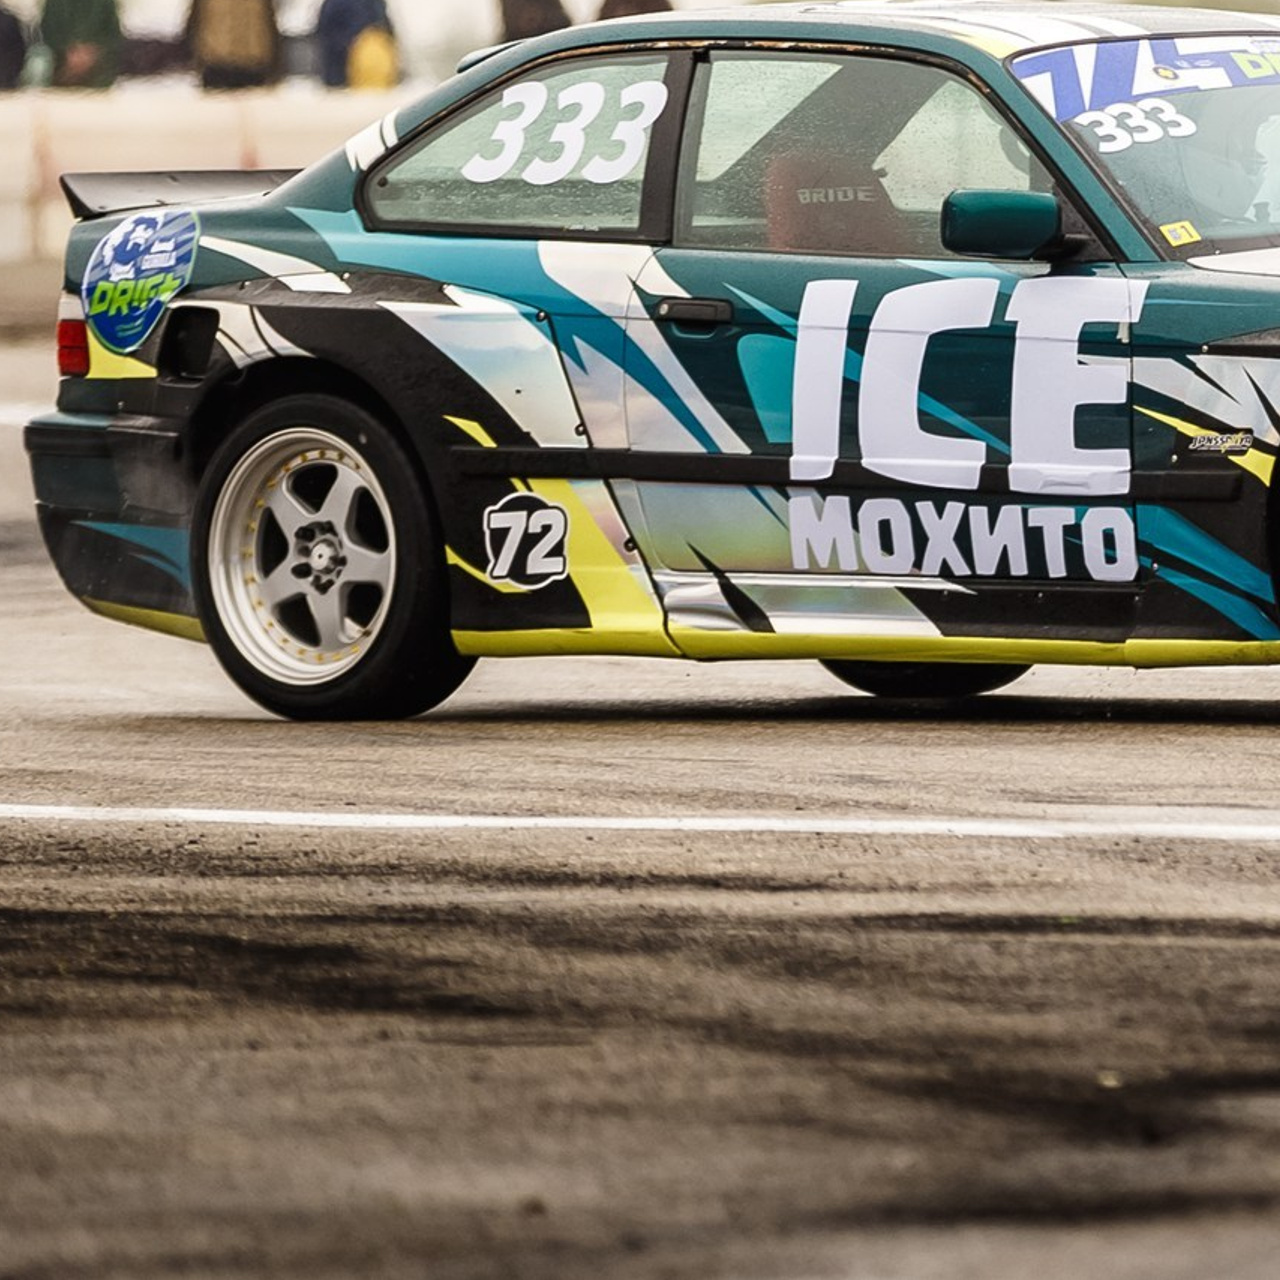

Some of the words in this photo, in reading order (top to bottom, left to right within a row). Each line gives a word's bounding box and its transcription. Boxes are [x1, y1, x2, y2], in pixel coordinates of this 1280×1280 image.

[460, 81, 669, 185] 333
[1074, 97, 1197, 154] 333
[797, 186, 876, 204] BRIDE
[89, 272, 182, 316] DRIFT
[789, 276, 1151, 496] ICE
[489, 508, 567, 577] 72
[788, 495, 1140, 582] МОХИТО
